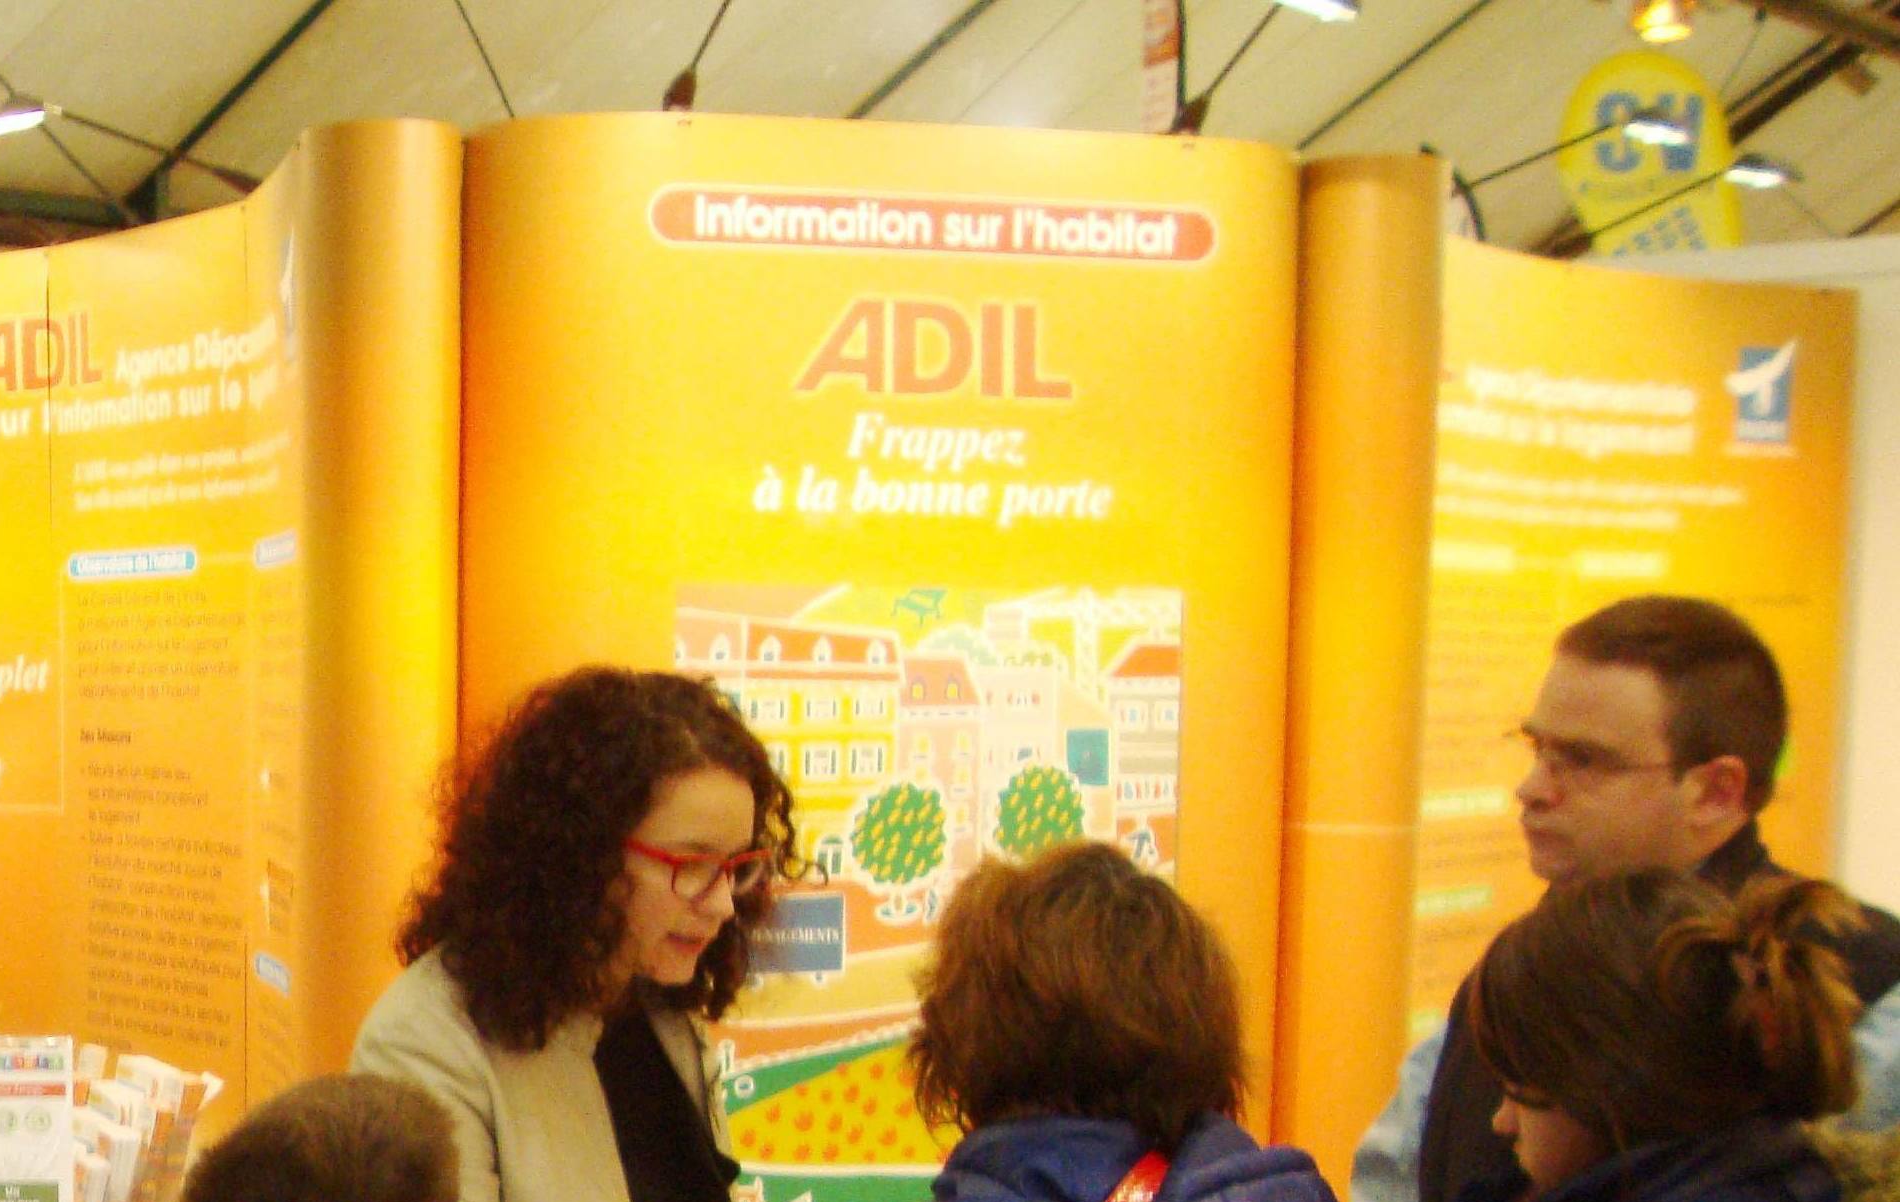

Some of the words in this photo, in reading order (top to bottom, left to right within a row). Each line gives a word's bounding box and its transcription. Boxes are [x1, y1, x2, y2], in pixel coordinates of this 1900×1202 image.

[694, 193, 931, 245] Information
[943, 210, 1003, 248] sur
[1012, 207, 1177, 257] l'habitat
[114, 342, 190, 386] Agence
[795, 299, 1073, 400] ADIL
[41, 390, 172, 434] l'information
[178, 383, 211, 417] sur
[218, 368, 242, 412] le
[846, 411, 1030, 473] Frappez
[752, 463, 784, 512] à
[795, 464, 839, 512] la
[850, 465, 994, 514] bonne
[998, 478, 1114, 531] porte
